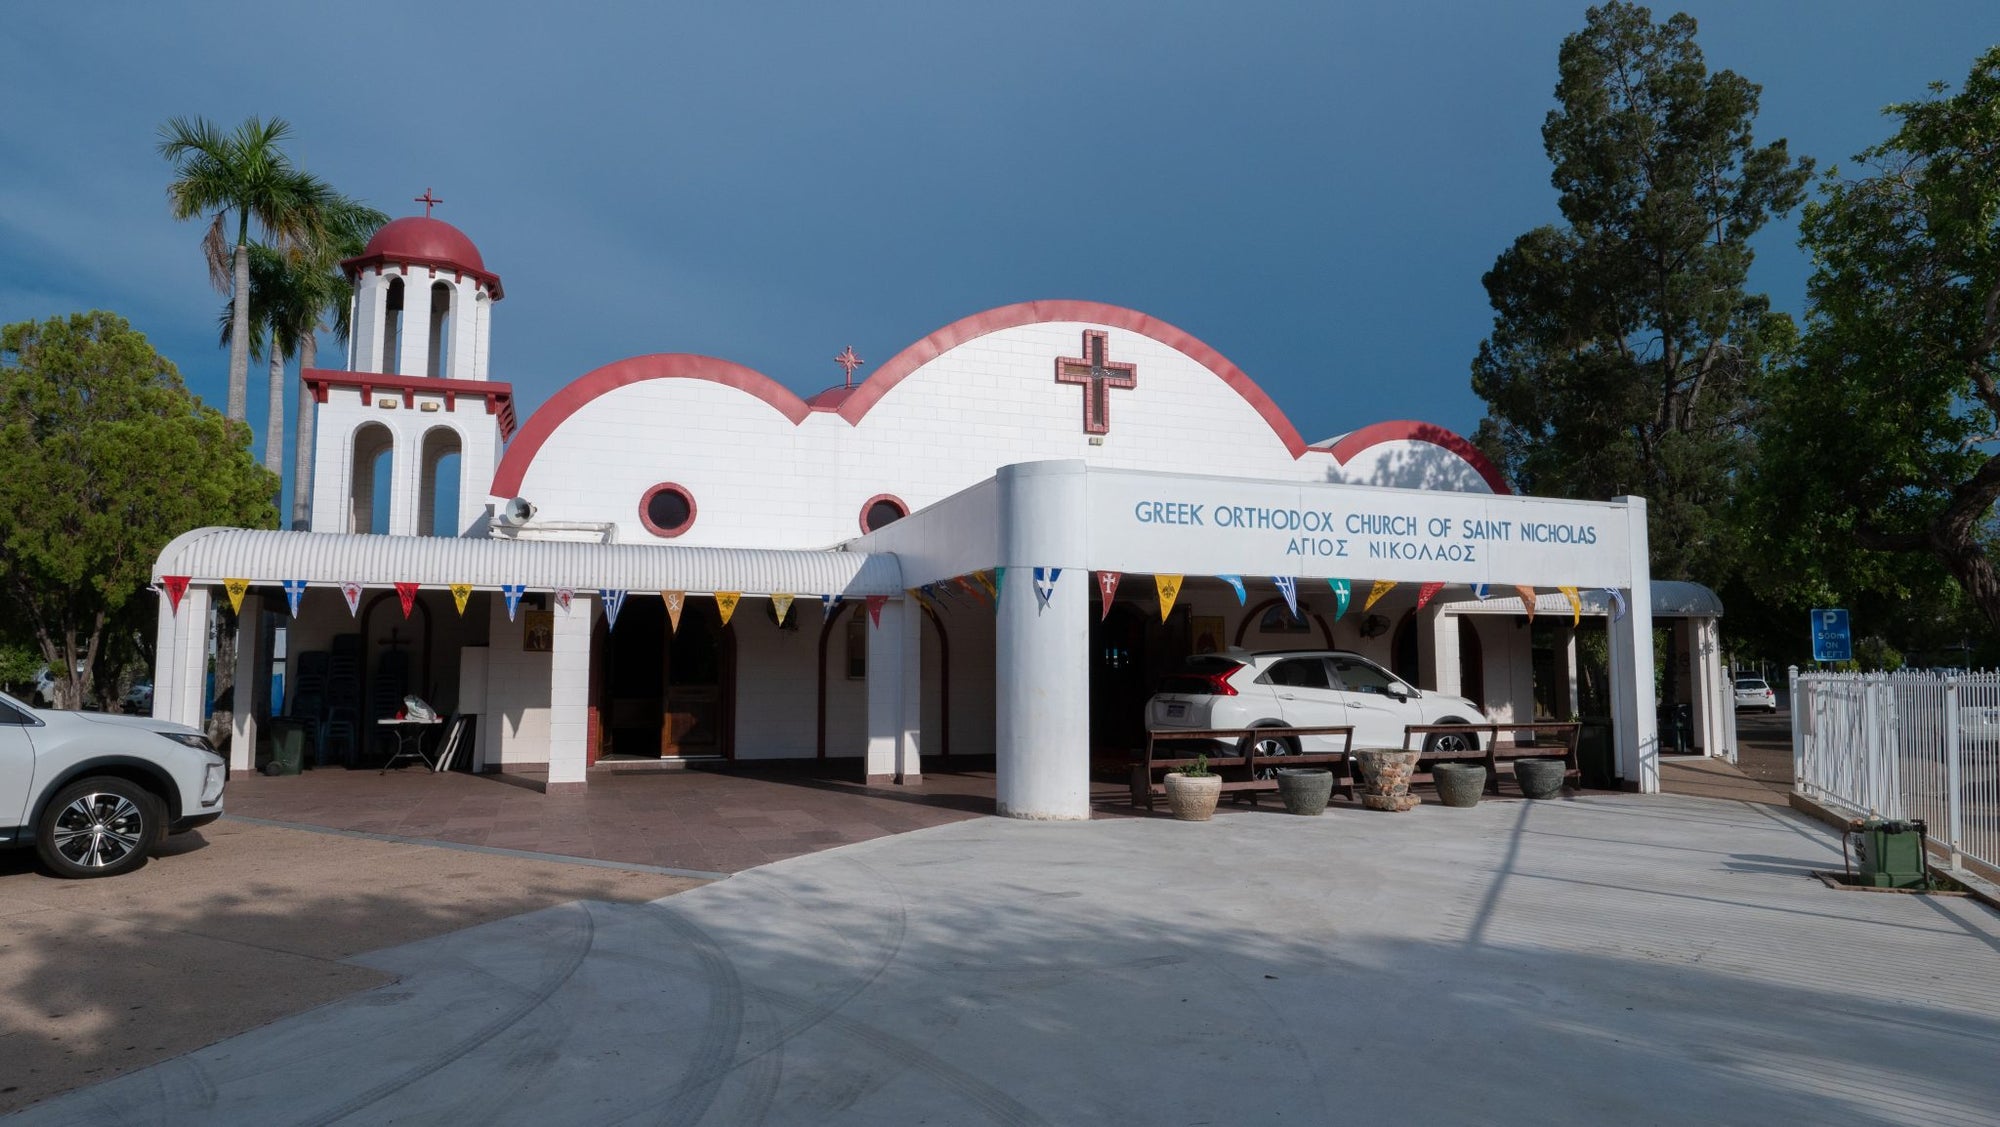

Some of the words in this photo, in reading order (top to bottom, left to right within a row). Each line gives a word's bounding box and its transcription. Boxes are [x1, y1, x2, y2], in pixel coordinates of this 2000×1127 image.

[1135, 501, 1204, 525] GREEK
[1214, 506, 1334, 532] ORTHODOX
[1345, 513, 1417, 537] CHURCH
[1428, 517, 1451, 538] OF
[1463, 519, 1512, 541] SAINT
[1519, 522, 1598, 545] NICHOLAS
[1286, 537, 1349, 557] ΑΓΙΟΣ
[1370, 541, 1476, 562] ΝΙΚΟΛΑΟΣ
[1823, 611, 1837, 630] P
[1820, 650, 1845, 659] LEFT
[1825, 641, 1838, 649] ON
